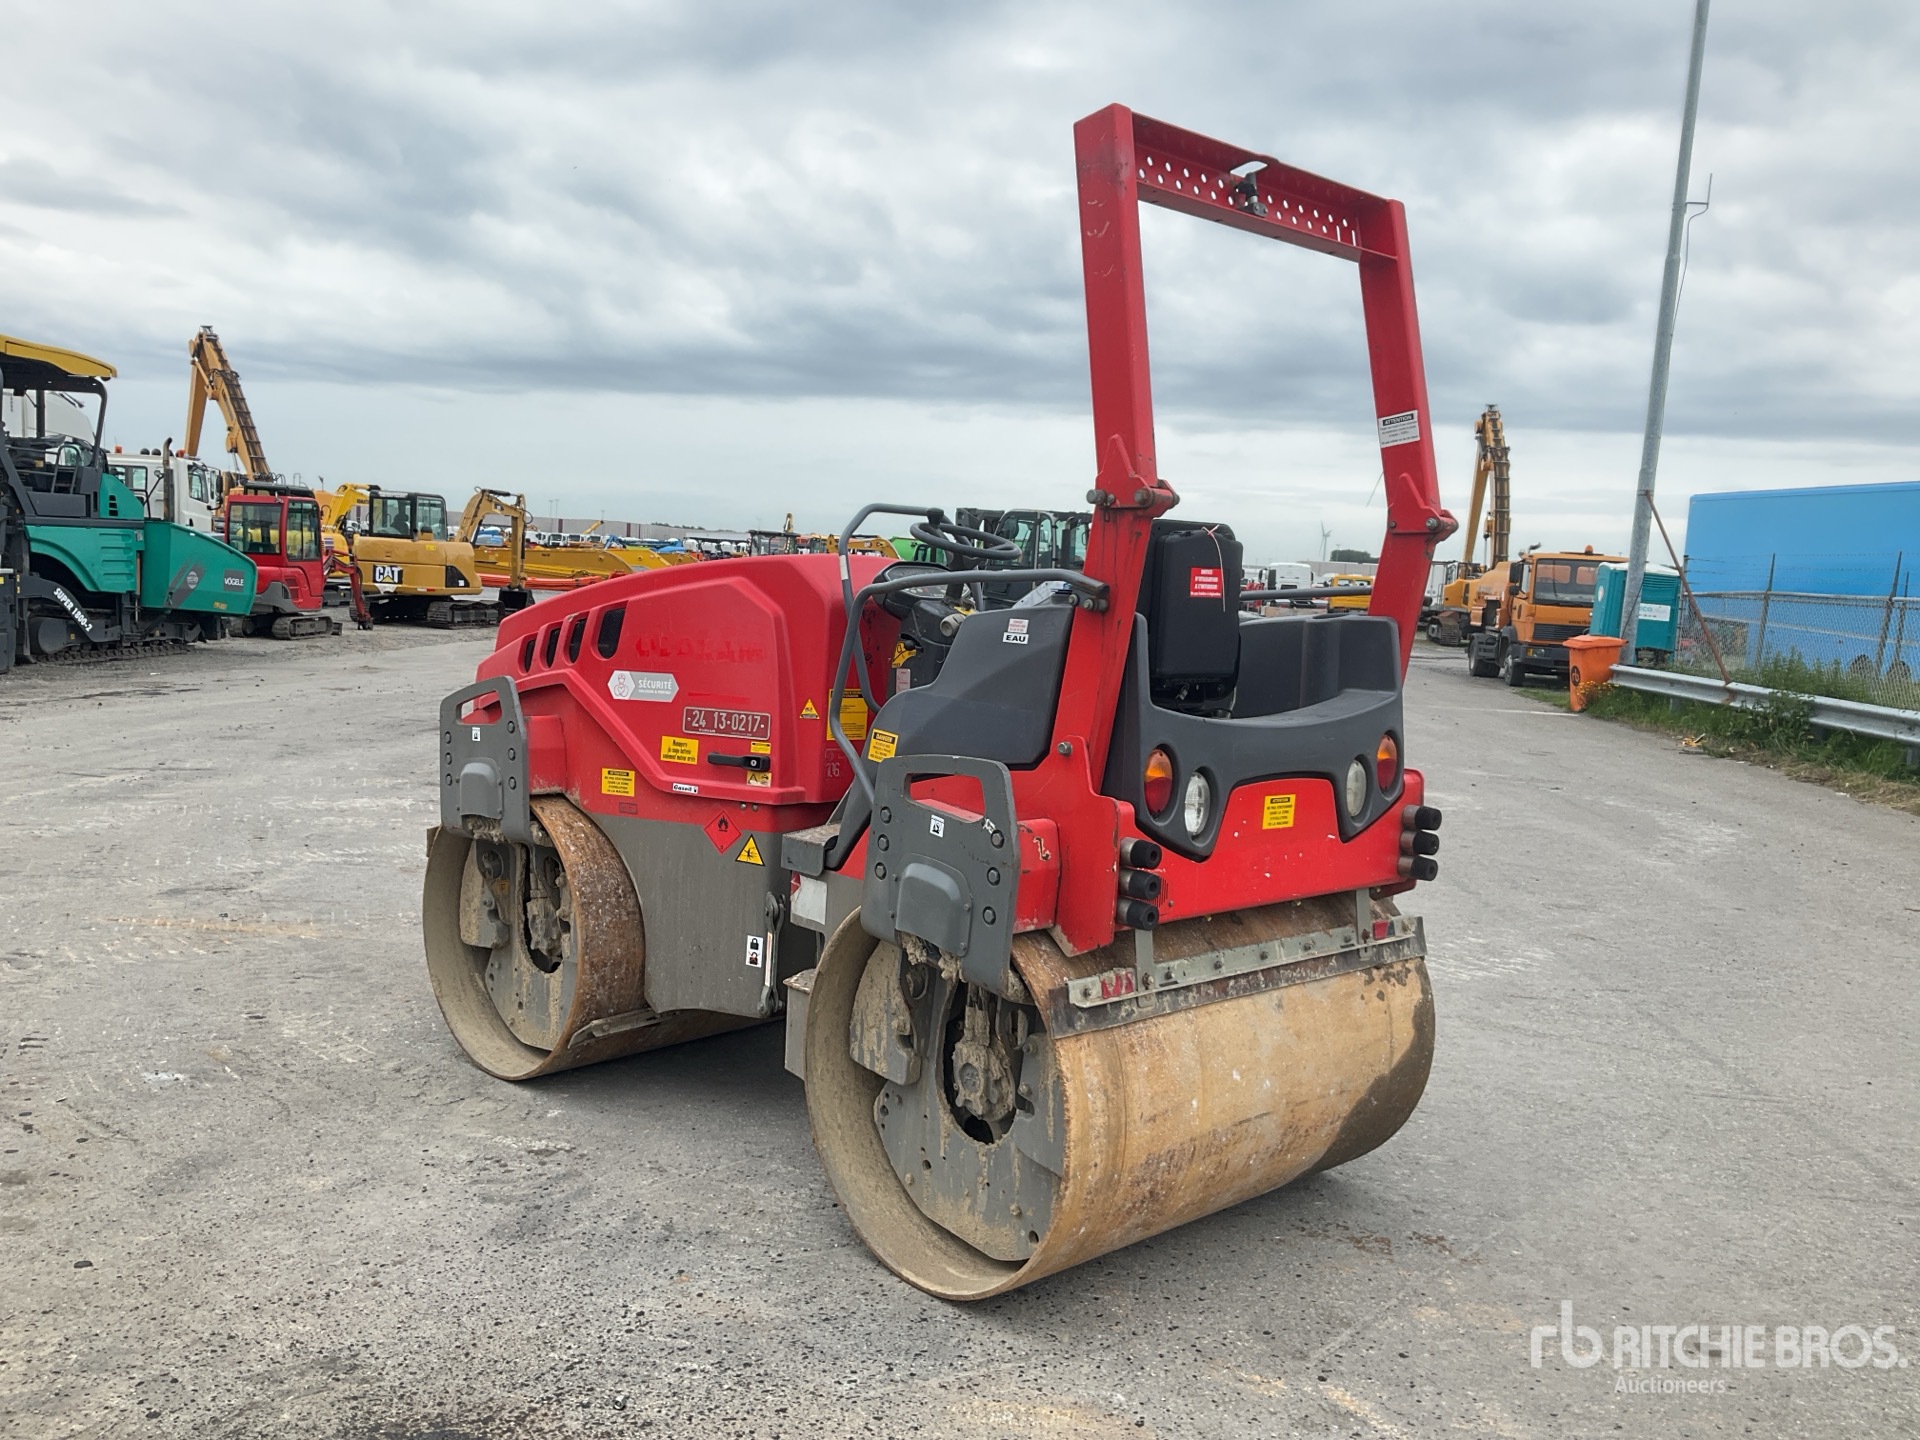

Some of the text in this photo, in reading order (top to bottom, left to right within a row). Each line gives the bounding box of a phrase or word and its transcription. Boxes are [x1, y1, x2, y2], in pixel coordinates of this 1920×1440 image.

[1384, 414, 1413, 425] ATTENTION
[375, 566, 403, 584] CAT
[224, 577, 244, 587] VÖGELE
[53, 588, 93, 632] SUPER 1800-2
[1006, 634, 1026, 643] EAU
[638, 677, 673, 690] SÉCURITÉ
[691, 710, 706, 728] 24
[876, 733, 893, 743] DANGER
